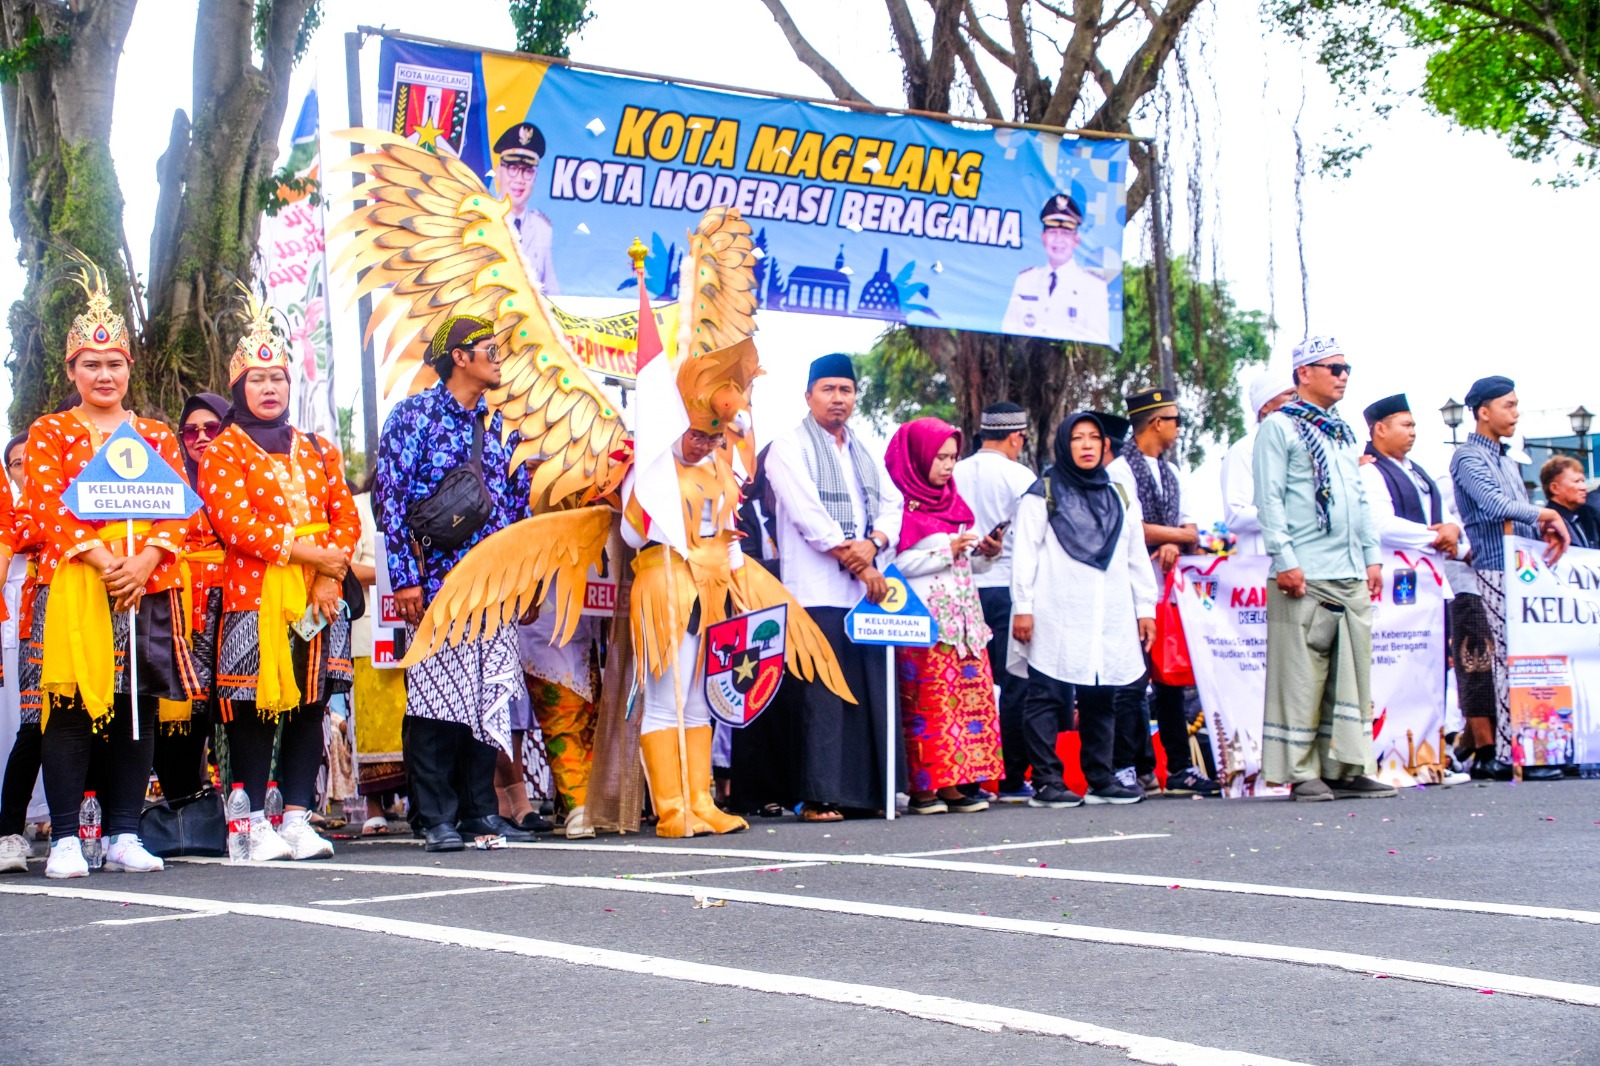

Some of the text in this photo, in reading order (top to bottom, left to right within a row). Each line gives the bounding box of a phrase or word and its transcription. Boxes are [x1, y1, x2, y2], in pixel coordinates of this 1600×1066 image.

[400, 69, 468, 86] KOTA MAGELANG
[614, 105, 983, 199] KOTA MAGELANG
[551, 157, 1022, 249] KOTA MODERASI BERAGAMA
[119, 448, 133, 469] 1
[88, 484, 174, 495] KELURAHAN
[94, 499, 171, 510] GELANGAN
[886, 587, 898, 603] 2
[864, 618, 919, 626] KELURAHAN
[858, 628, 926, 638] TIDAR SELATAN
[1391, 642, 1427, 652] Beragama
